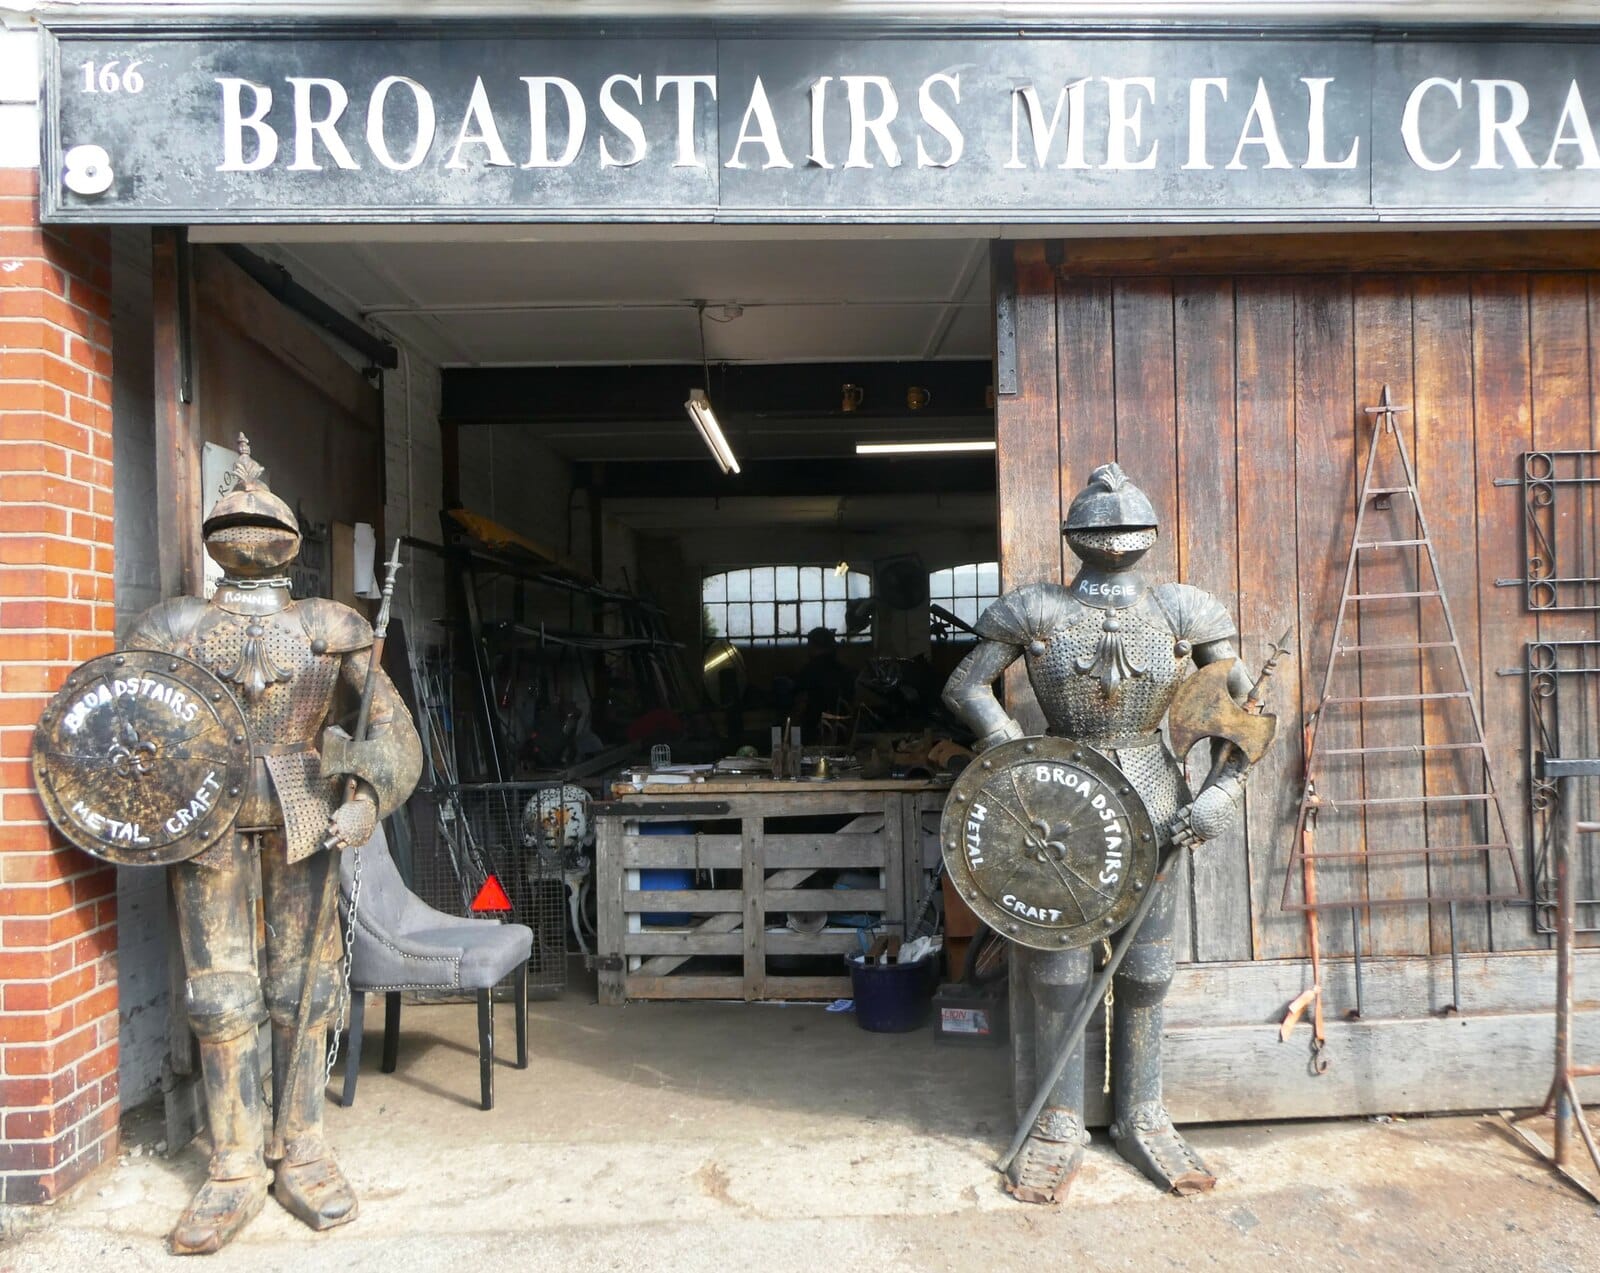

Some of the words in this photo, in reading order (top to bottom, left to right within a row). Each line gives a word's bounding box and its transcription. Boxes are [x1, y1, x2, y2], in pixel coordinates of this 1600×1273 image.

[80, 61, 144, 94] 166
[213, 72, 966, 173] BROADSTAIRS
[1002, 75, 1359, 171] METAL
[1400, 76, 1600, 171] CRA
[224, 591, 278, 605] RONNIE
[1078, 579, 1136, 596] REGGIE
[63, 678, 198, 734] BROADSTAIRS
[71, 799, 151, 844] METAL
[165, 771, 223, 834] CRAFT
[1036, 765, 1123, 885] BROADSTAIRS
[966, 803, 988, 870] METAL
[1002, 894, 1063, 922] CRAFT
